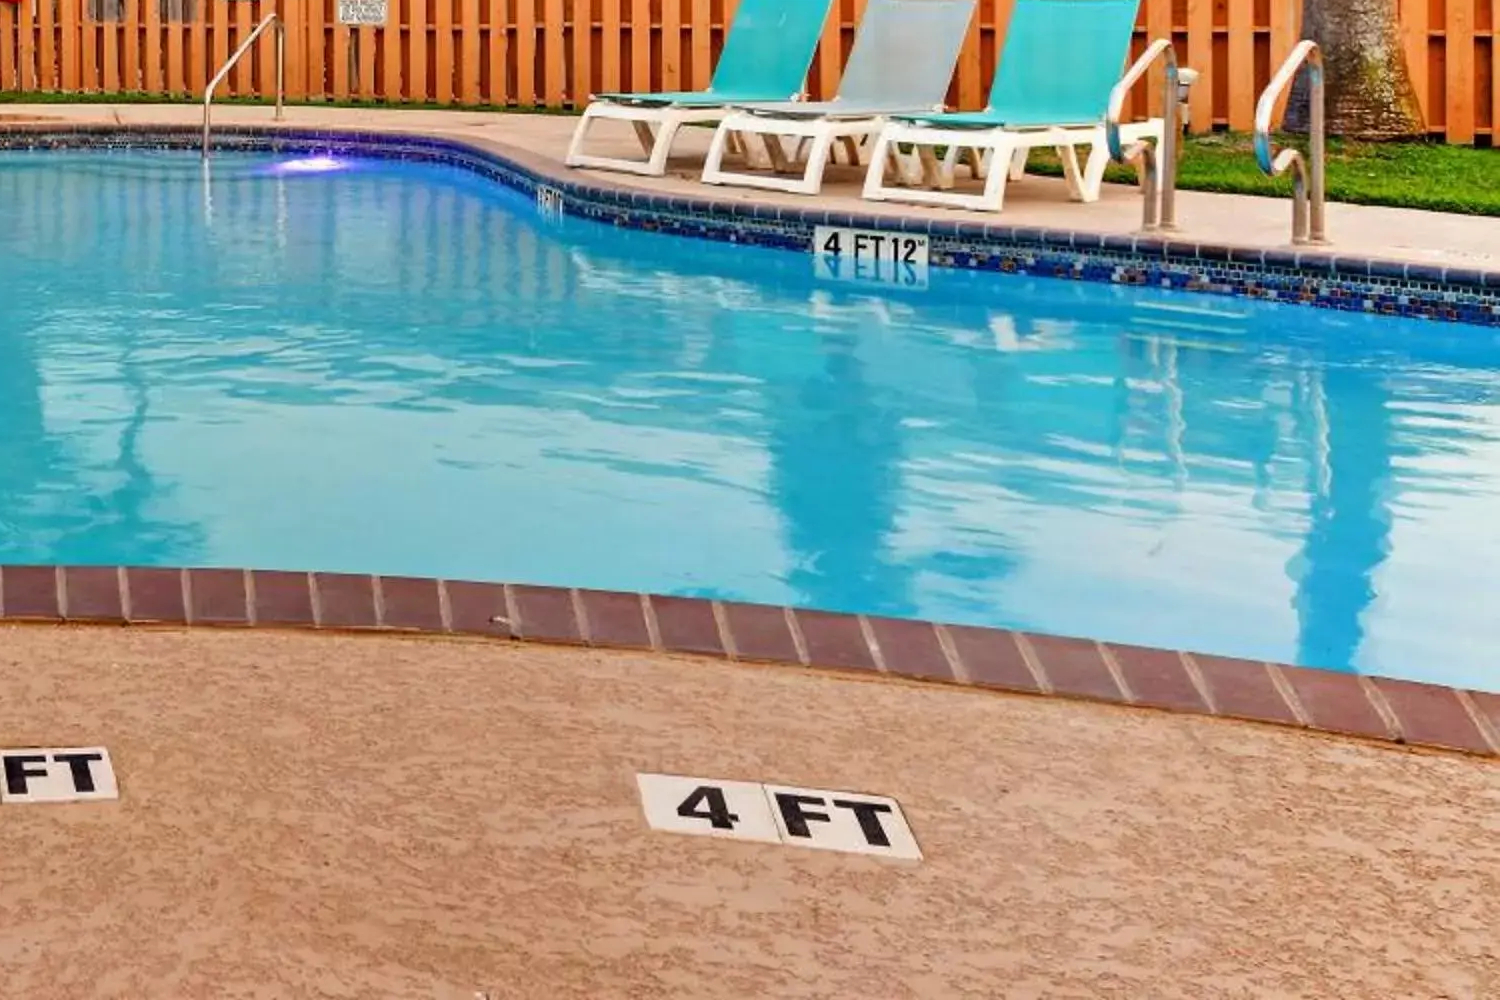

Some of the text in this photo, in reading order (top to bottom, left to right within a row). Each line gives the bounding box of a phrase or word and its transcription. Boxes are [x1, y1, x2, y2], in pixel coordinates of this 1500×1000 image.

[824, 232, 916, 264] 4 FT 12
[3, 754, 102, 794] FT
[677, 786, 892, 847] 4 FT
